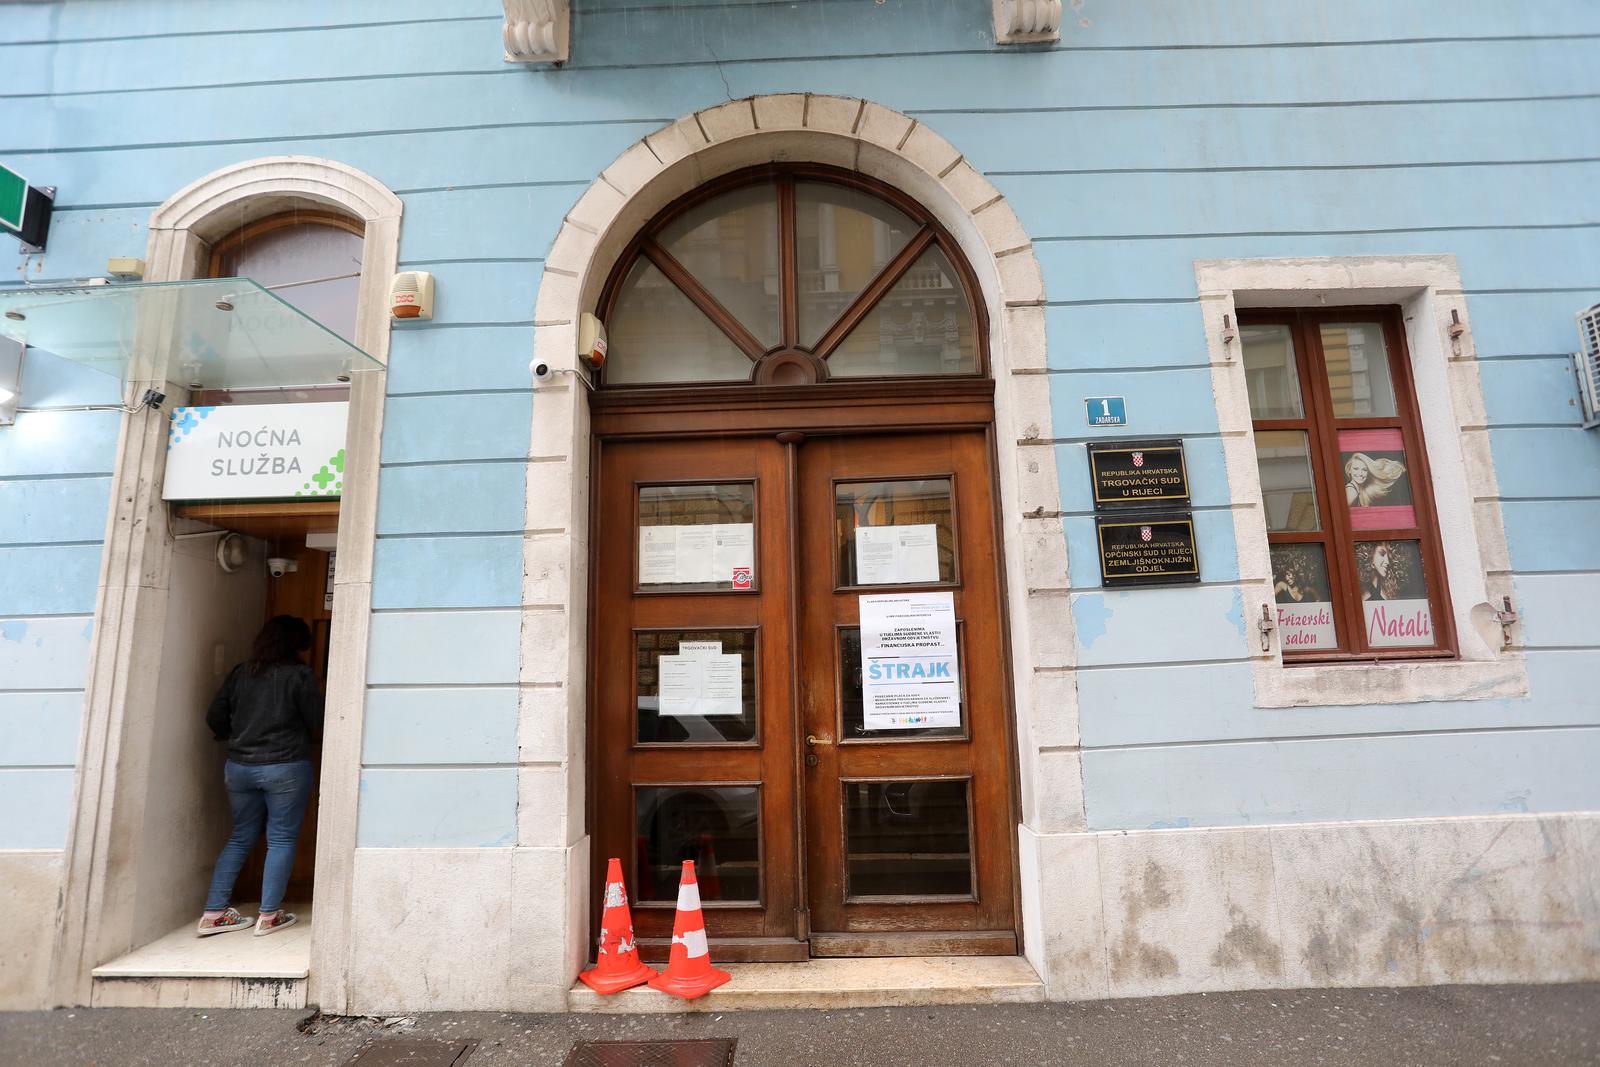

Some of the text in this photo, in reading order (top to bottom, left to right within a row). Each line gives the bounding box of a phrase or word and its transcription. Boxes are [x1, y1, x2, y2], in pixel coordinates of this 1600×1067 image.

[1101, 399, 1110, 416] 1
[1095, 416, 1120, 424] ZADARSKA
[217, 425, 301, 448] NOĆNA
[211, 453, 302, 476] SLUŽBA
[1101, 469, 1140, 477] REPUBLIKA
[1101, 477, 1159, 487] TRGOVAČKI
[1132, 488, 1163, 496] RIJECI
[1108, 556, 1192, 567] ZEMLJIŠNOKNJIŽNI
[1276, 607, 1330, 627] Frizerski
[1369, 605, 1429, 644] Natali
[1285, 630, 1317, 645] salon
[869, 660, 950, 680] ŠTRAJK
